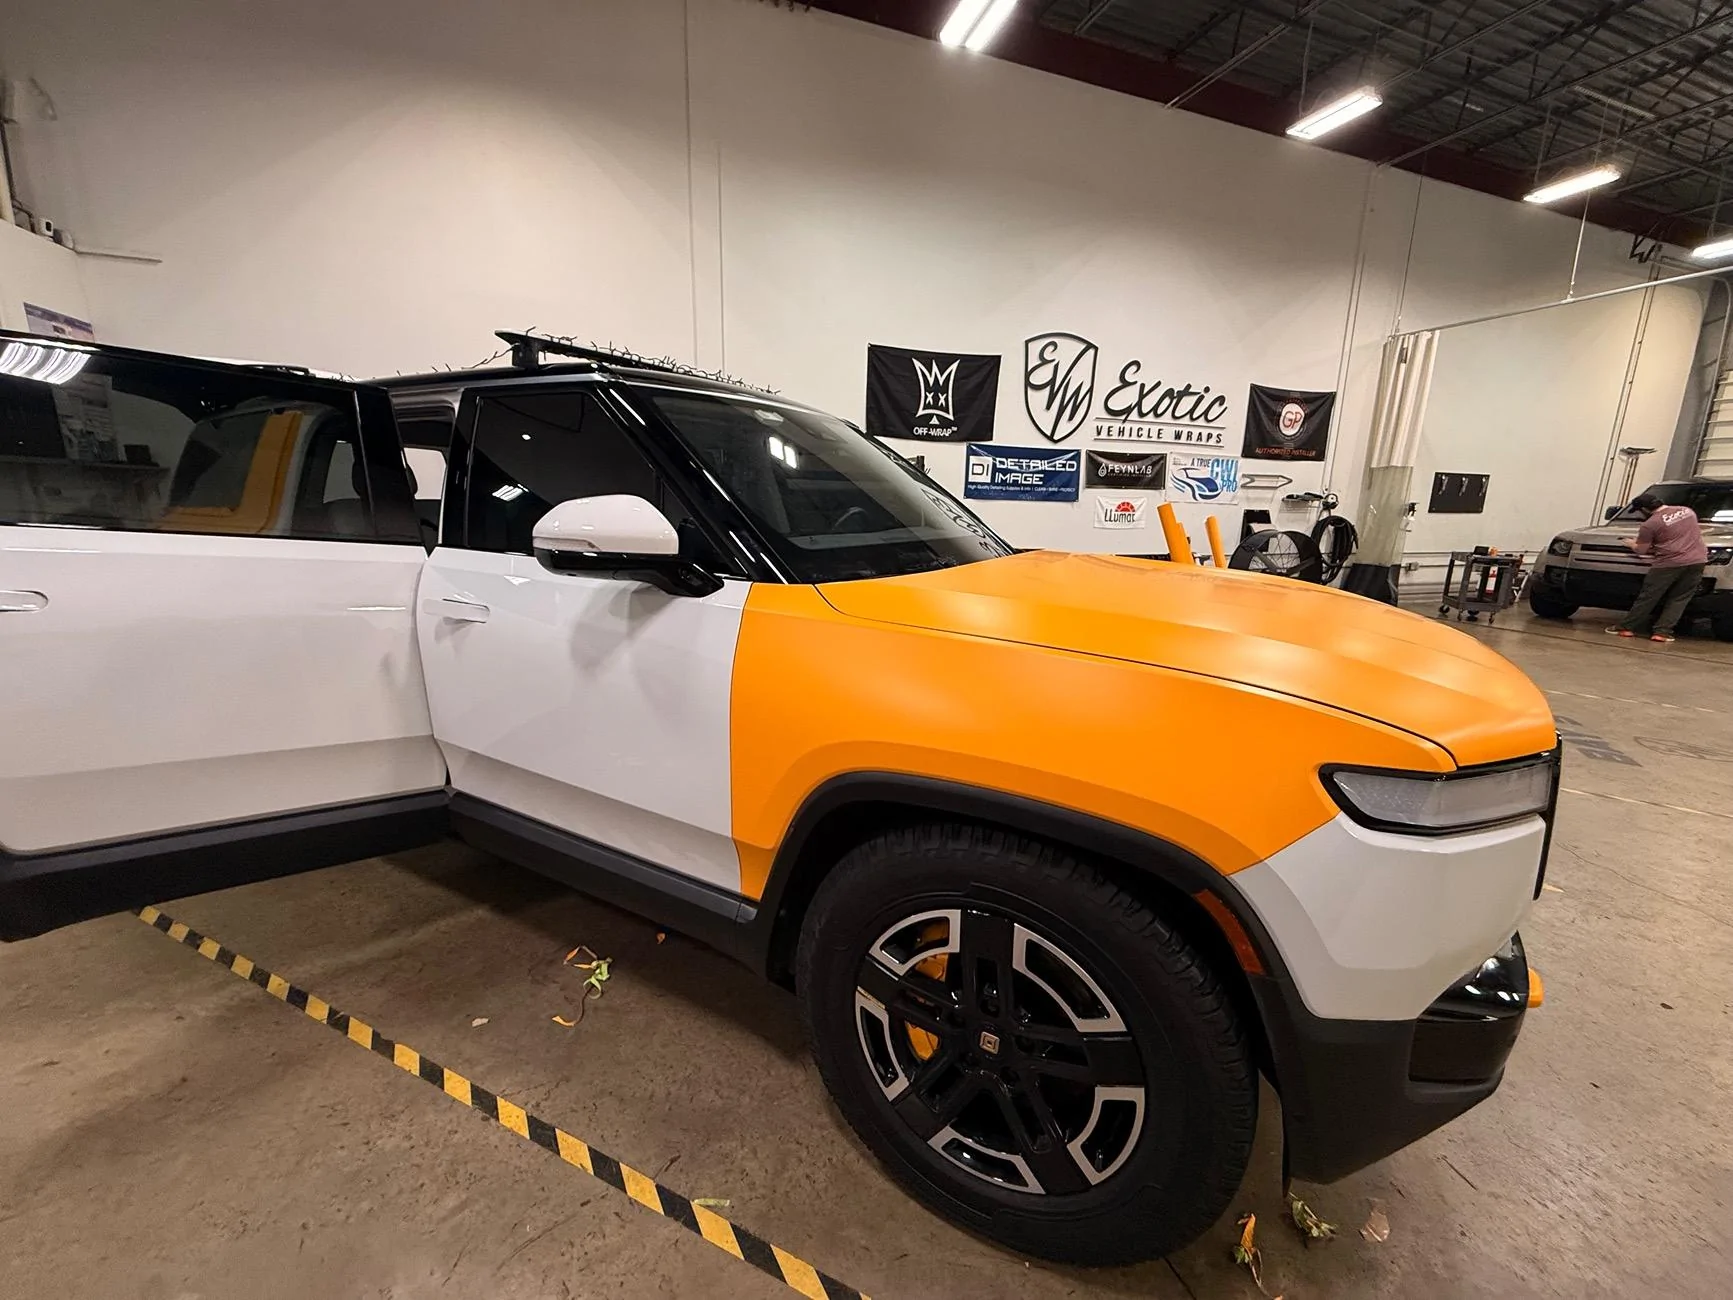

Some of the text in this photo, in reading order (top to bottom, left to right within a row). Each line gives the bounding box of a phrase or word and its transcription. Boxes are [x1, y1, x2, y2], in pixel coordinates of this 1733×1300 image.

[1104, 360, 1228, 423] Exotic
[1282, 411, 1303, 429] GP
[1096, 425, 1224, 444] VEHICLE WRAPS
[1255, 447, 1316, 457] AUTHORIZED INSTALLER
[996, 457, 1077, 471] DETAILED
[1196, 457, 1211, 467] TRUE
[971, 463, 990, 476] DI
[1108, 464, 1153, 474] FEYNLAB
[995, 472, 1044, 485] IMAGE
[1220, 479, 1238, 493] PRO
